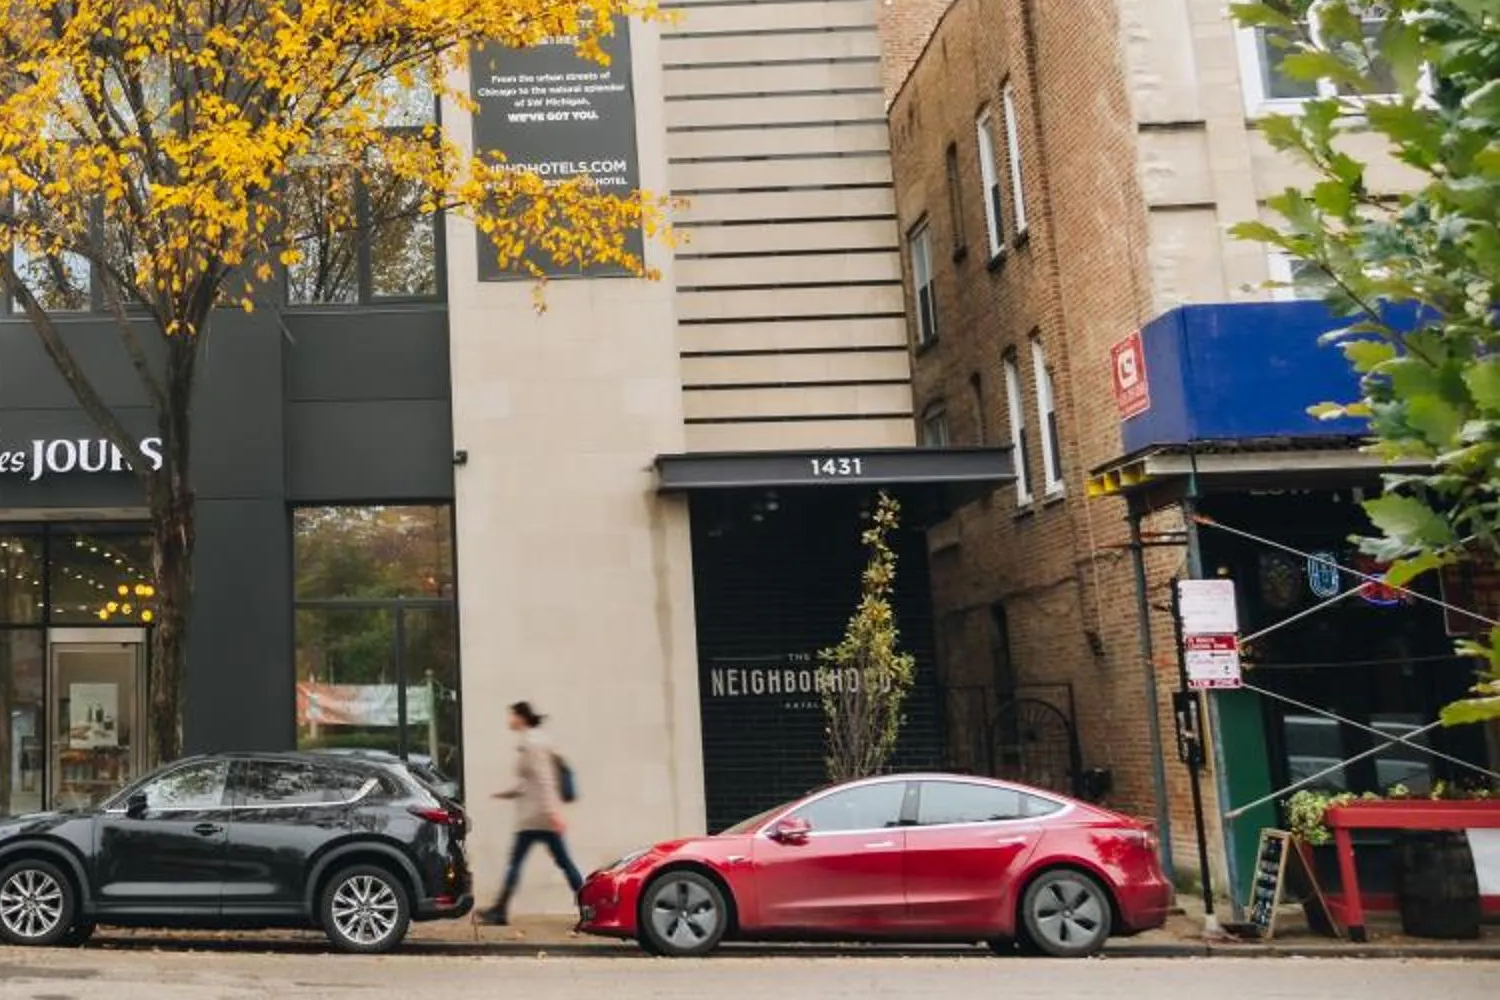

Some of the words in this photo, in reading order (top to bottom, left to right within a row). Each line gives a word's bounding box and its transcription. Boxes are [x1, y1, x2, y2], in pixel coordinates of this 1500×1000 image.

[491, 75, 517, 84] From
[519, 74, 534, 83] the
[535, 73, 564, 82] urban
[566, 72, 598, 81] streets
[600, 71, 611, 80] of
[477, 88, 517, 98] Chicago
[518, 87, 529, 95] to
[531, 86, 546, 95] the
[548, 85, 582, 94] natural
[584, 84, 625, 94] splendor
[513, 99, 525, 107] of
[546, 112, 570, 122] GOT
[595, 177, 628, 186] HOTEL
[811, 457, 861, 475] 1431
[788, 653, 811, 661] THE
[711, 667, 892, 697] NEIGHBOHOD
